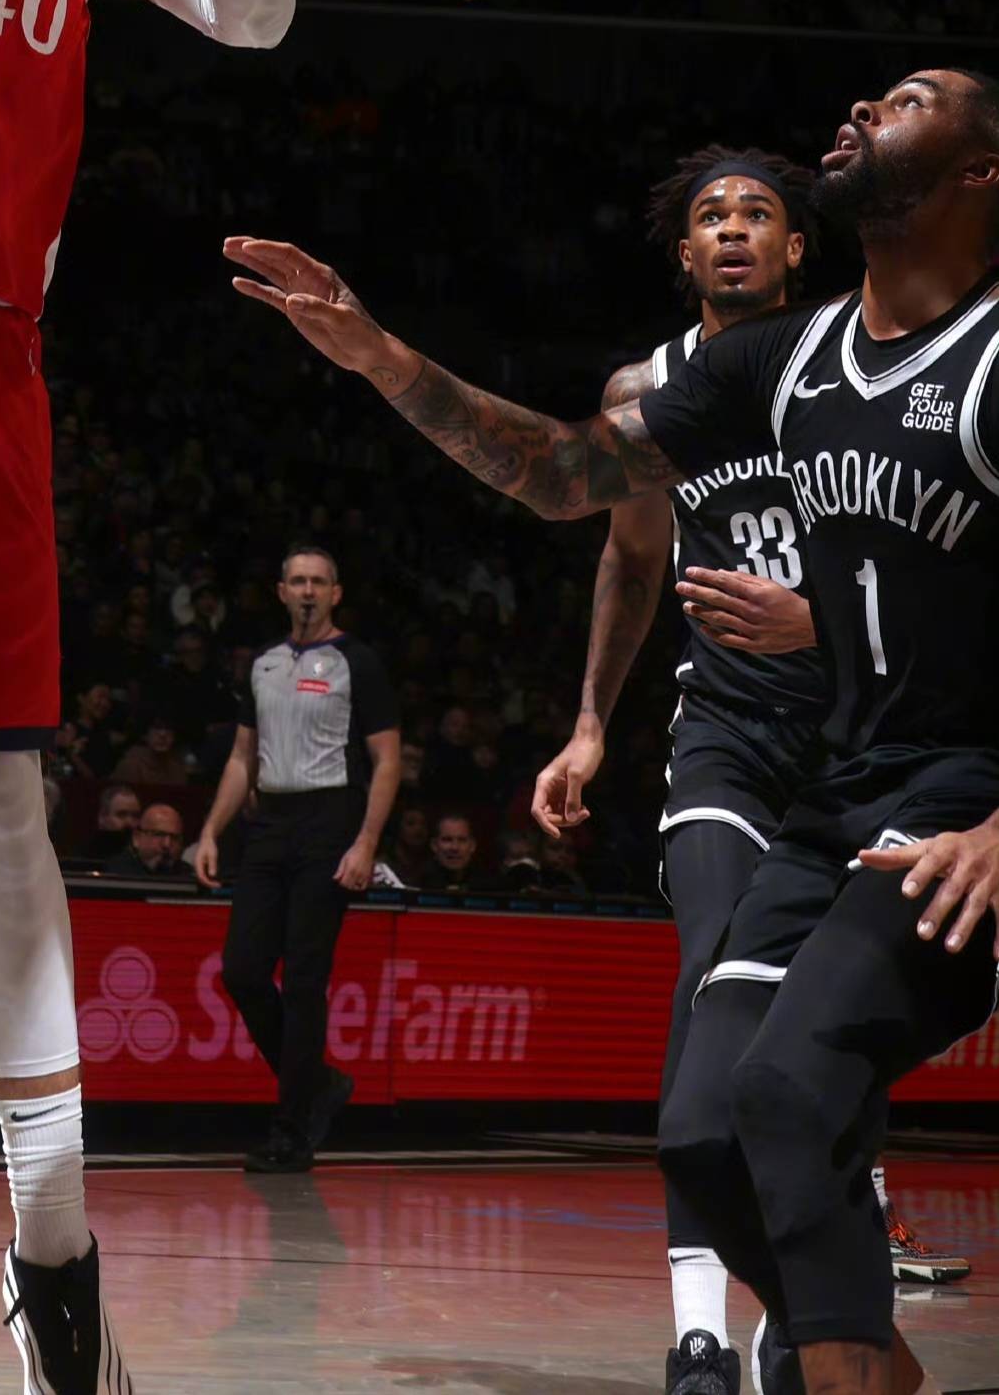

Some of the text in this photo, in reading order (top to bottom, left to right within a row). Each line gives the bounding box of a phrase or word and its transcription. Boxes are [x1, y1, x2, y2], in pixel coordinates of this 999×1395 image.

[911, 382, 945, 399] GET
[908, 396, 954, 416] YOUR
[902, 412, 954, 433] GUIDE
[729, 506, 803, 590] 33
[855, 558, 887, 675] 1
